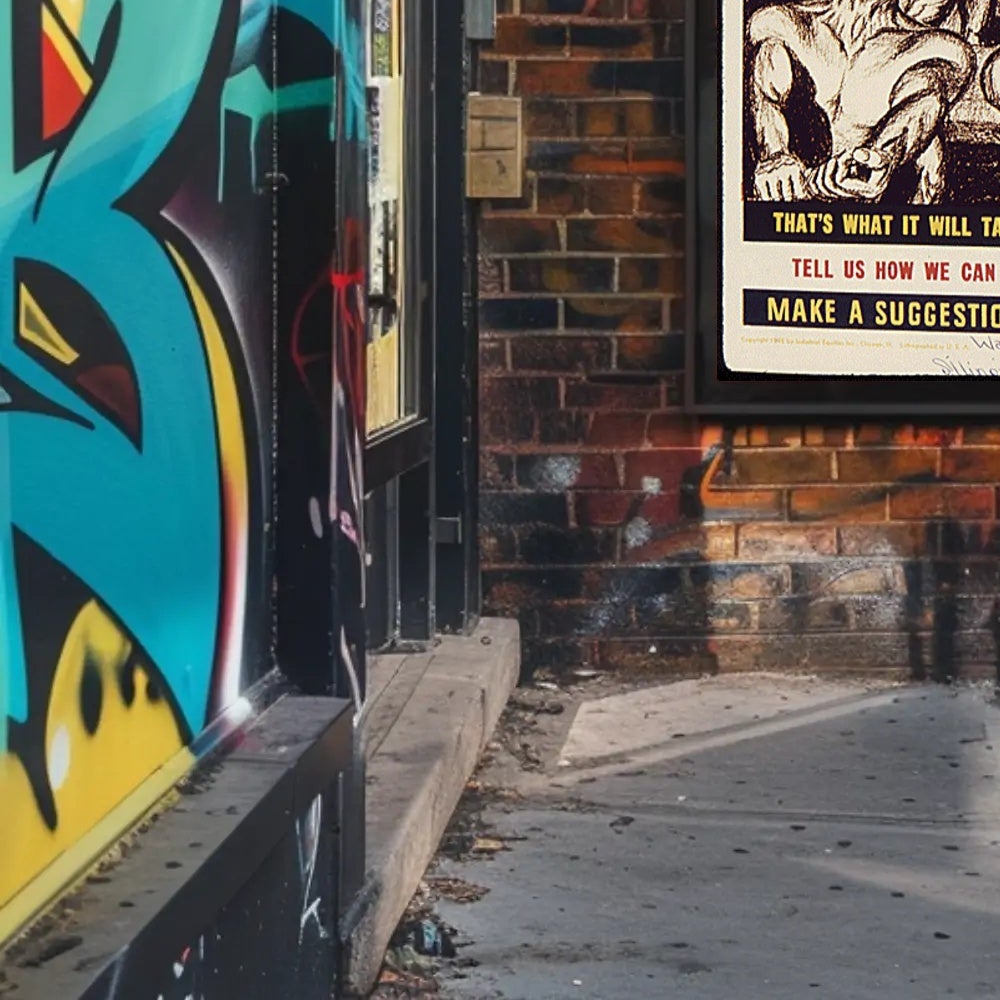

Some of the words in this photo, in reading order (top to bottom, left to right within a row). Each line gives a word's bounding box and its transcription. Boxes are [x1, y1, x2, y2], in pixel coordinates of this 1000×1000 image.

[773, 212, 833, 233] THAT'S
[843, 213, 893, 235] WHAT
[902, 215, 920, 236] IT
[929, 215, 972, 237] WILL
[792, 258, 833, 278] TELL
[844, 260, 865, 279] US
[875, 261, 914, 280] HOW
[925, 262, 950, 281] WE
[961, 263, 995, 282] CAN
[767, 297, 836, 323] MAKE
[849, 300, 864, 324] A
